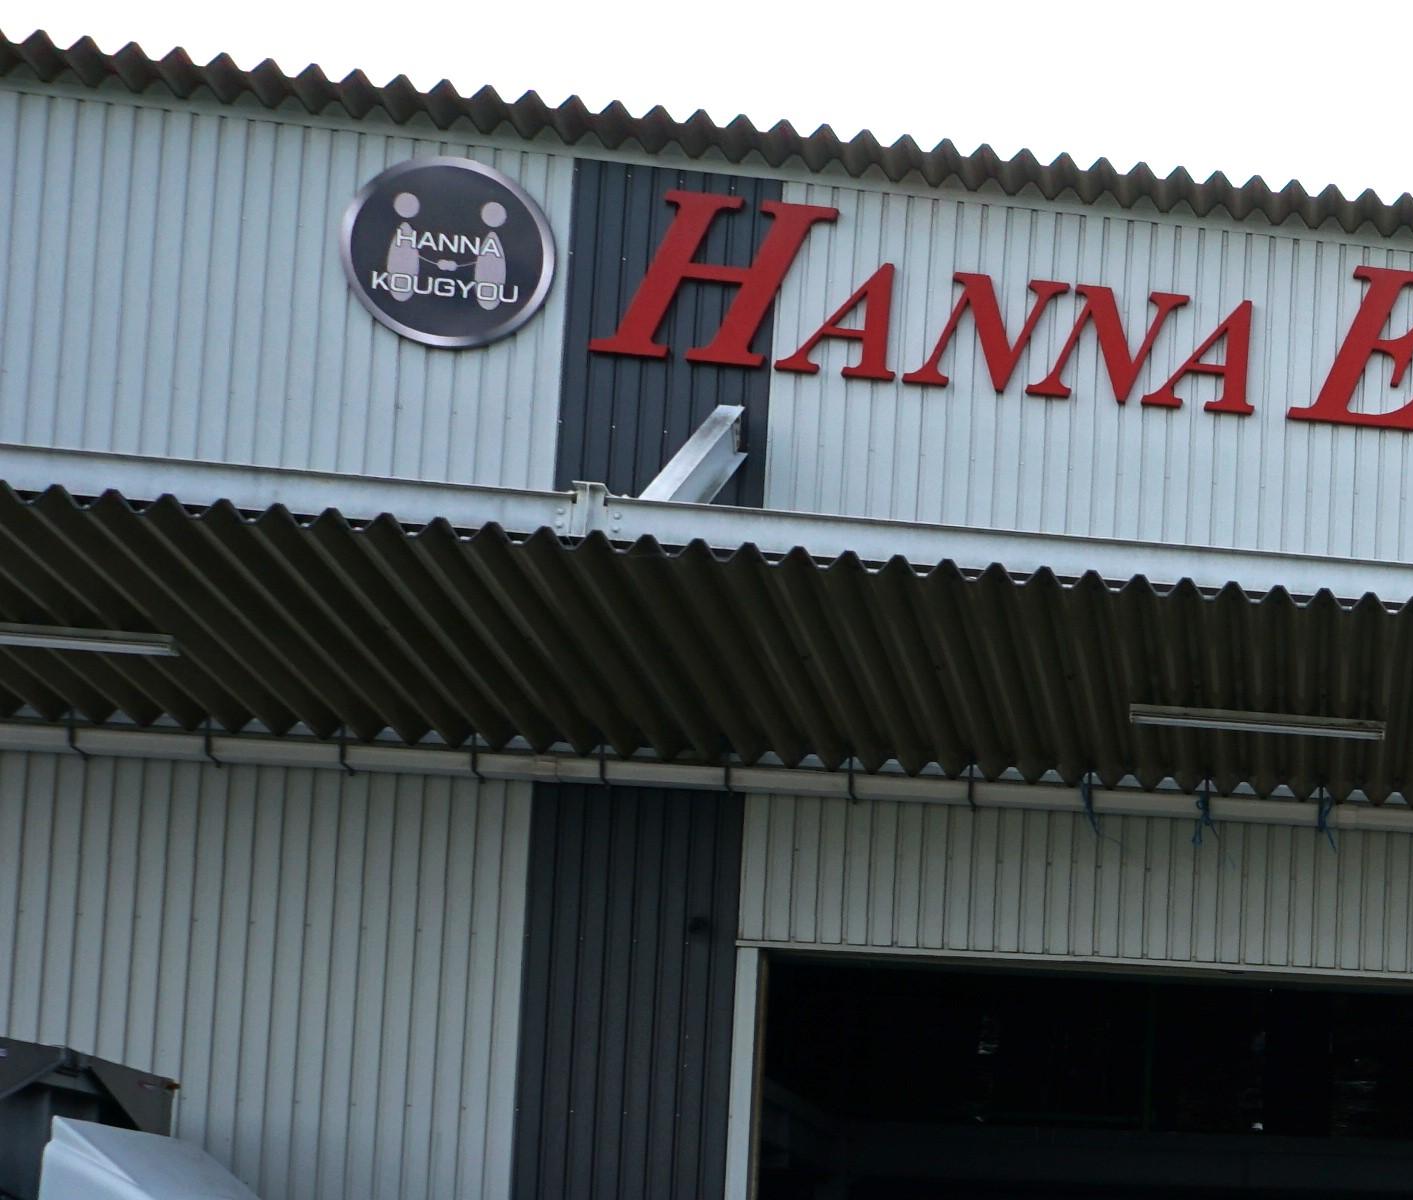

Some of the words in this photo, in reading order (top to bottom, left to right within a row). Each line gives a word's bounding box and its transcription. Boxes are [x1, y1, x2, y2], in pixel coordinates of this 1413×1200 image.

[395, 228, 502, 257] HANNA
[371, 270, 519, 304] KOUGYOU
[588, 190, 1255, 416] HANNA
